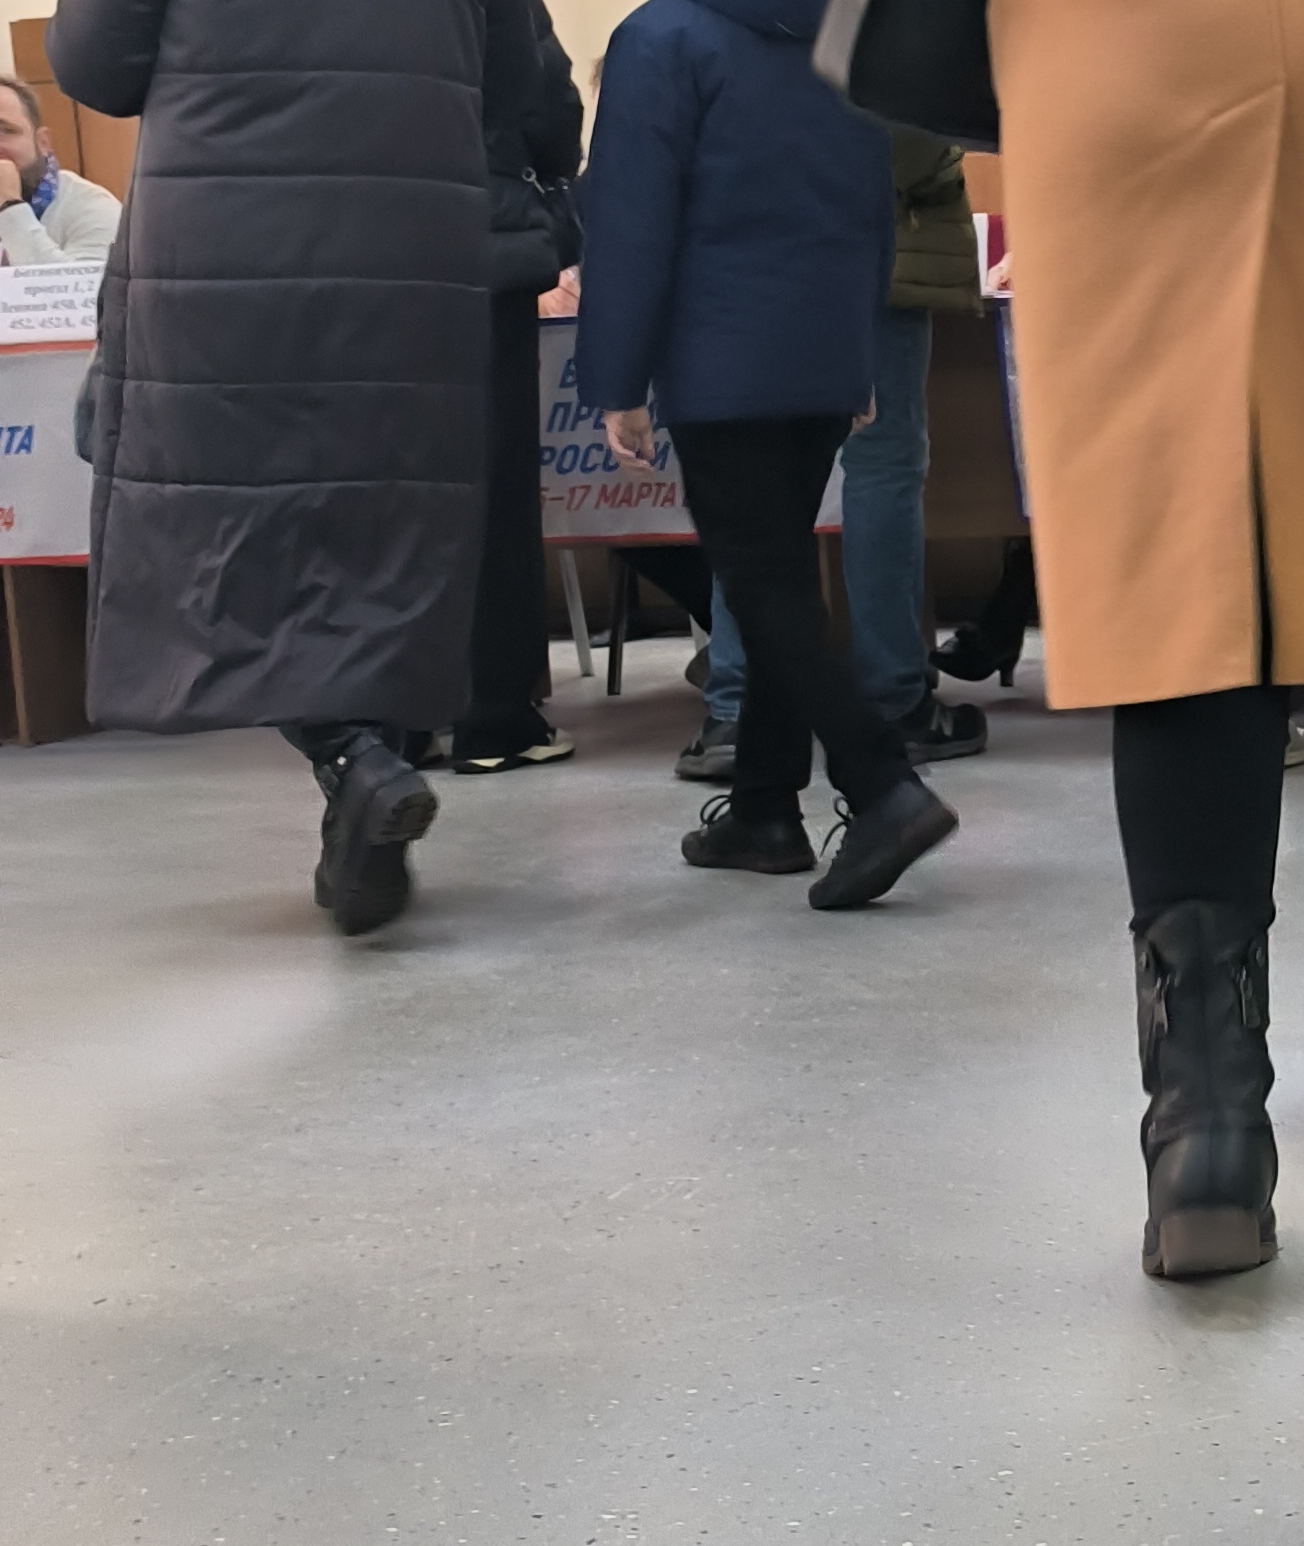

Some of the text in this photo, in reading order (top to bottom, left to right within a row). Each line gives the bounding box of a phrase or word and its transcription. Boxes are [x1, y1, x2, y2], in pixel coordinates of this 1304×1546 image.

[0, 425, 34, 455] ТА
[540, 440, 672, 475] РОССИ
[594, 482, 677, 510] МАРТА
